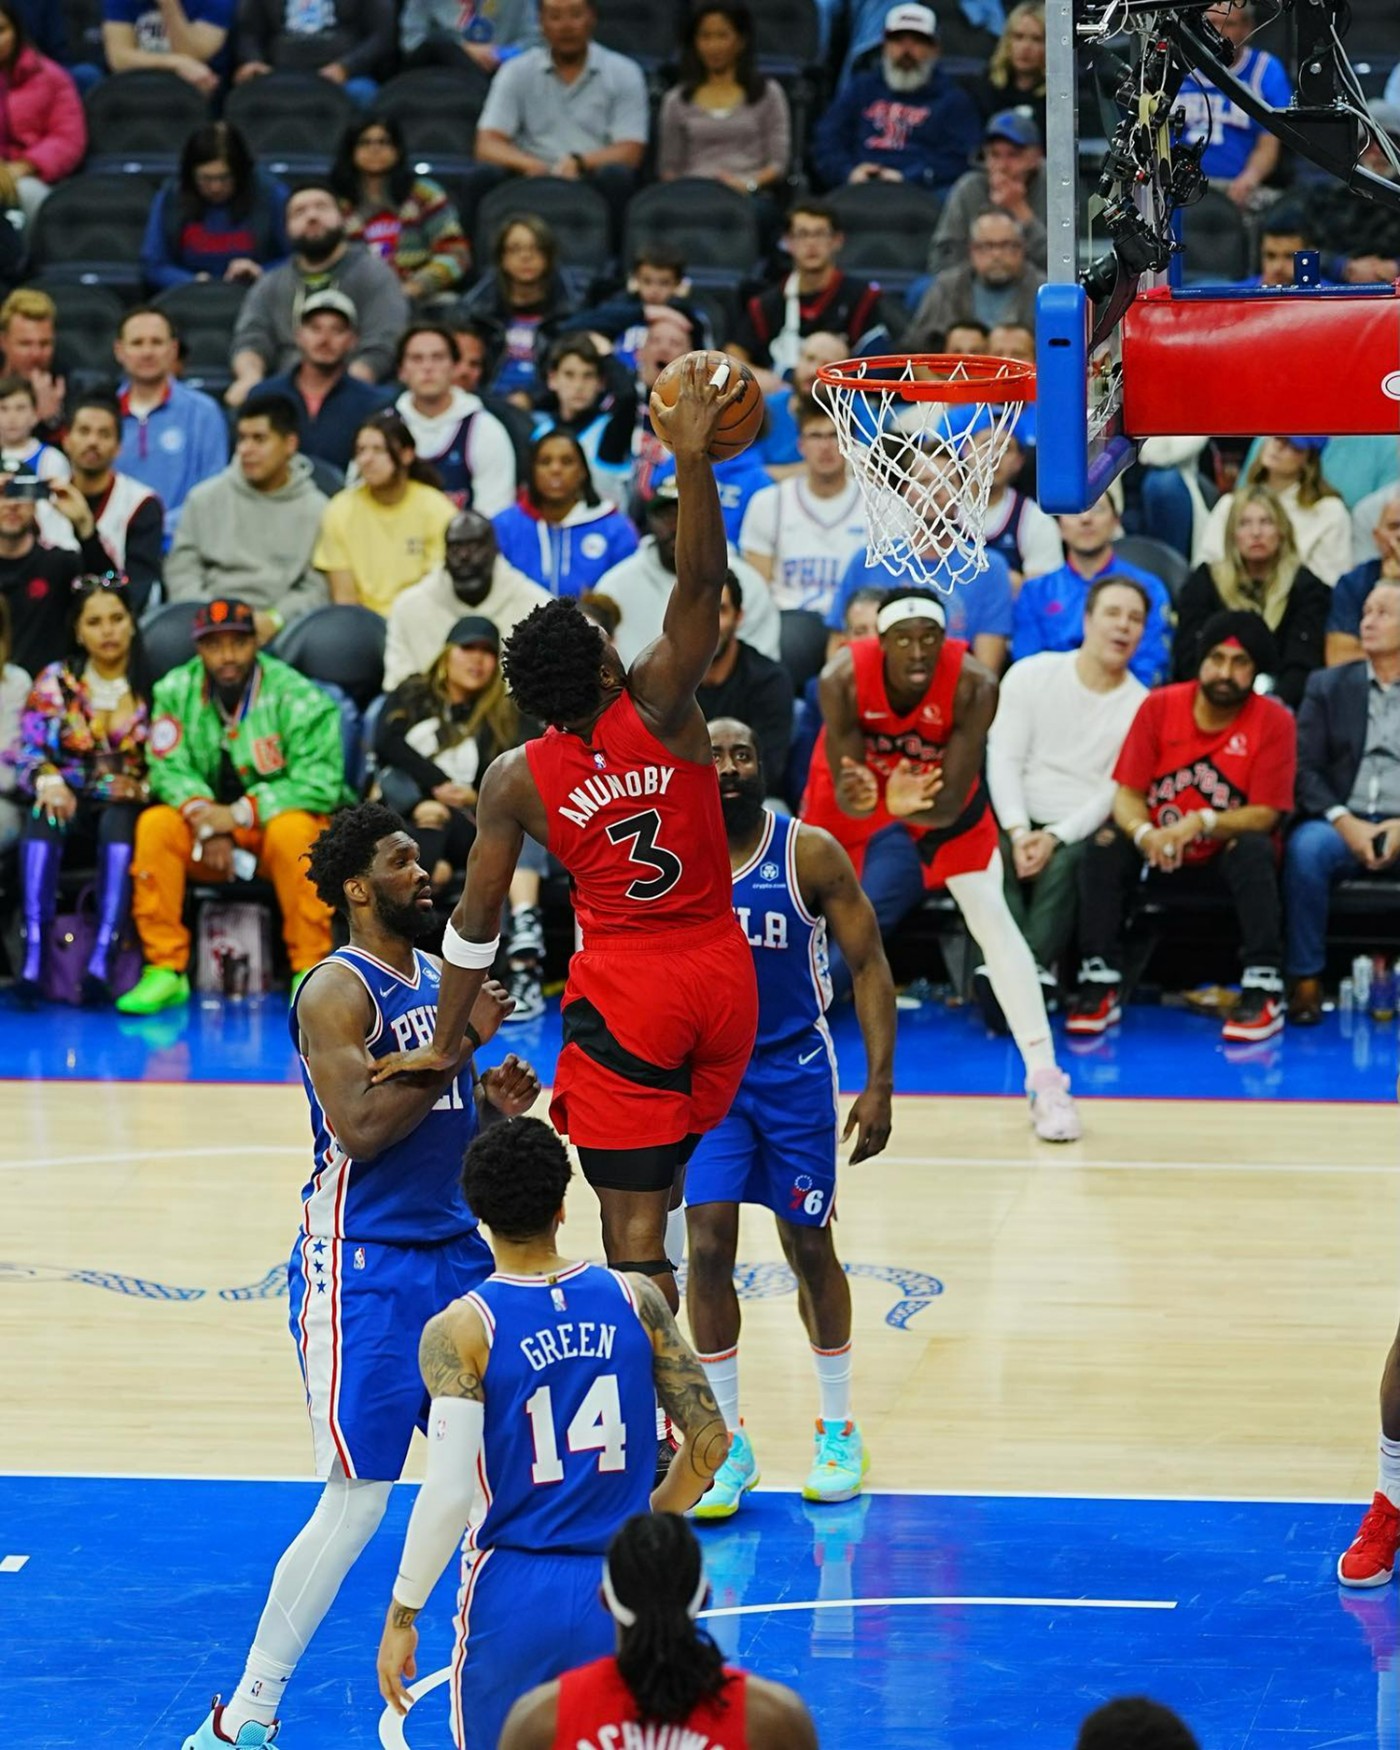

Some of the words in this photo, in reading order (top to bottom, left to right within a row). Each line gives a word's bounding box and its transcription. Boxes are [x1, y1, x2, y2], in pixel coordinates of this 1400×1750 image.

[558, 766, 675, 829] ANUNOBY
[605, 808, 682, 900] 3
[789, 1186, 824, 1215] 76
[520, 1322, 616, 1371] GREEN
[525, 1374, 627, 1484] 14
